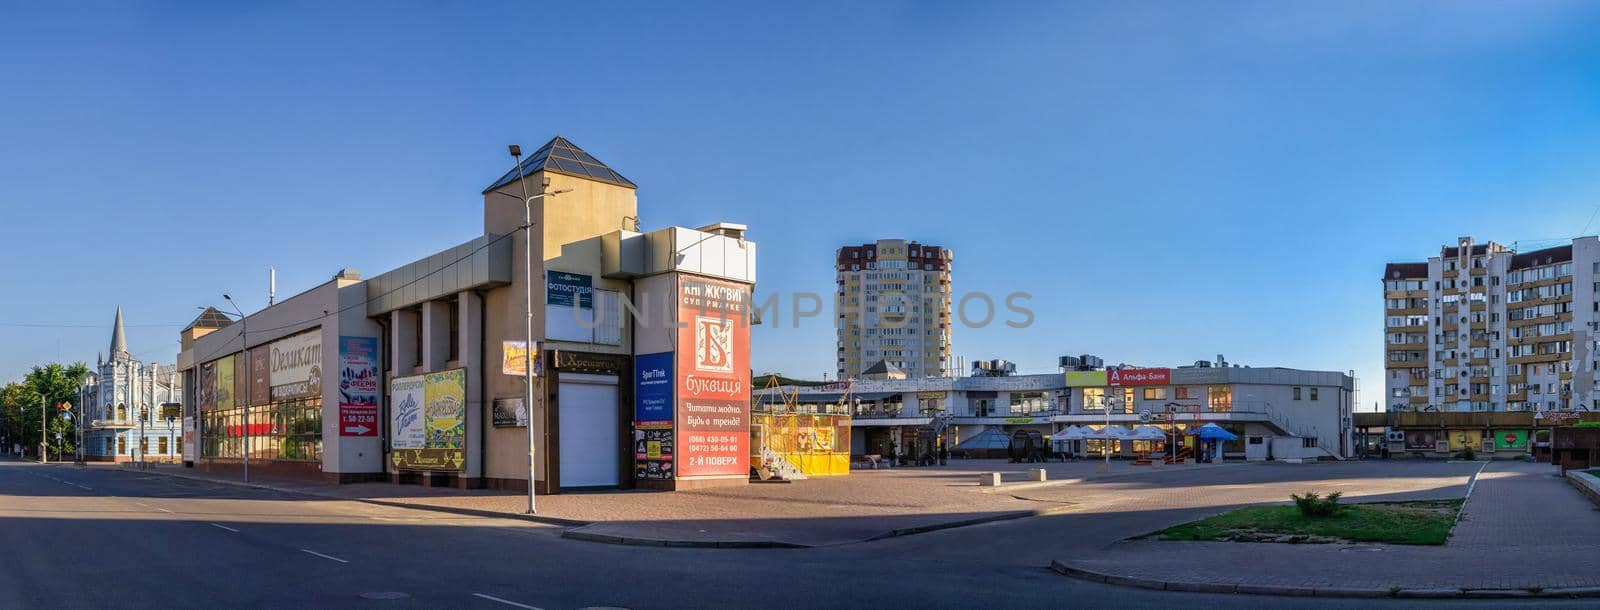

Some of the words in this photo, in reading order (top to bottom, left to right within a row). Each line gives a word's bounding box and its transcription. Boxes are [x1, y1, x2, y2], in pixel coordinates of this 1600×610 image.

[1123, 373, 1166, 382] Альфа-Банк
[686, 374, 742, 396] буквиця
[686, 402, 717, 414] Читати
[687, 415, 704, 428] Будь
[689, 444, 709, 452] (0472)
[705, 456, 737, 466] ПОВЕРХ
